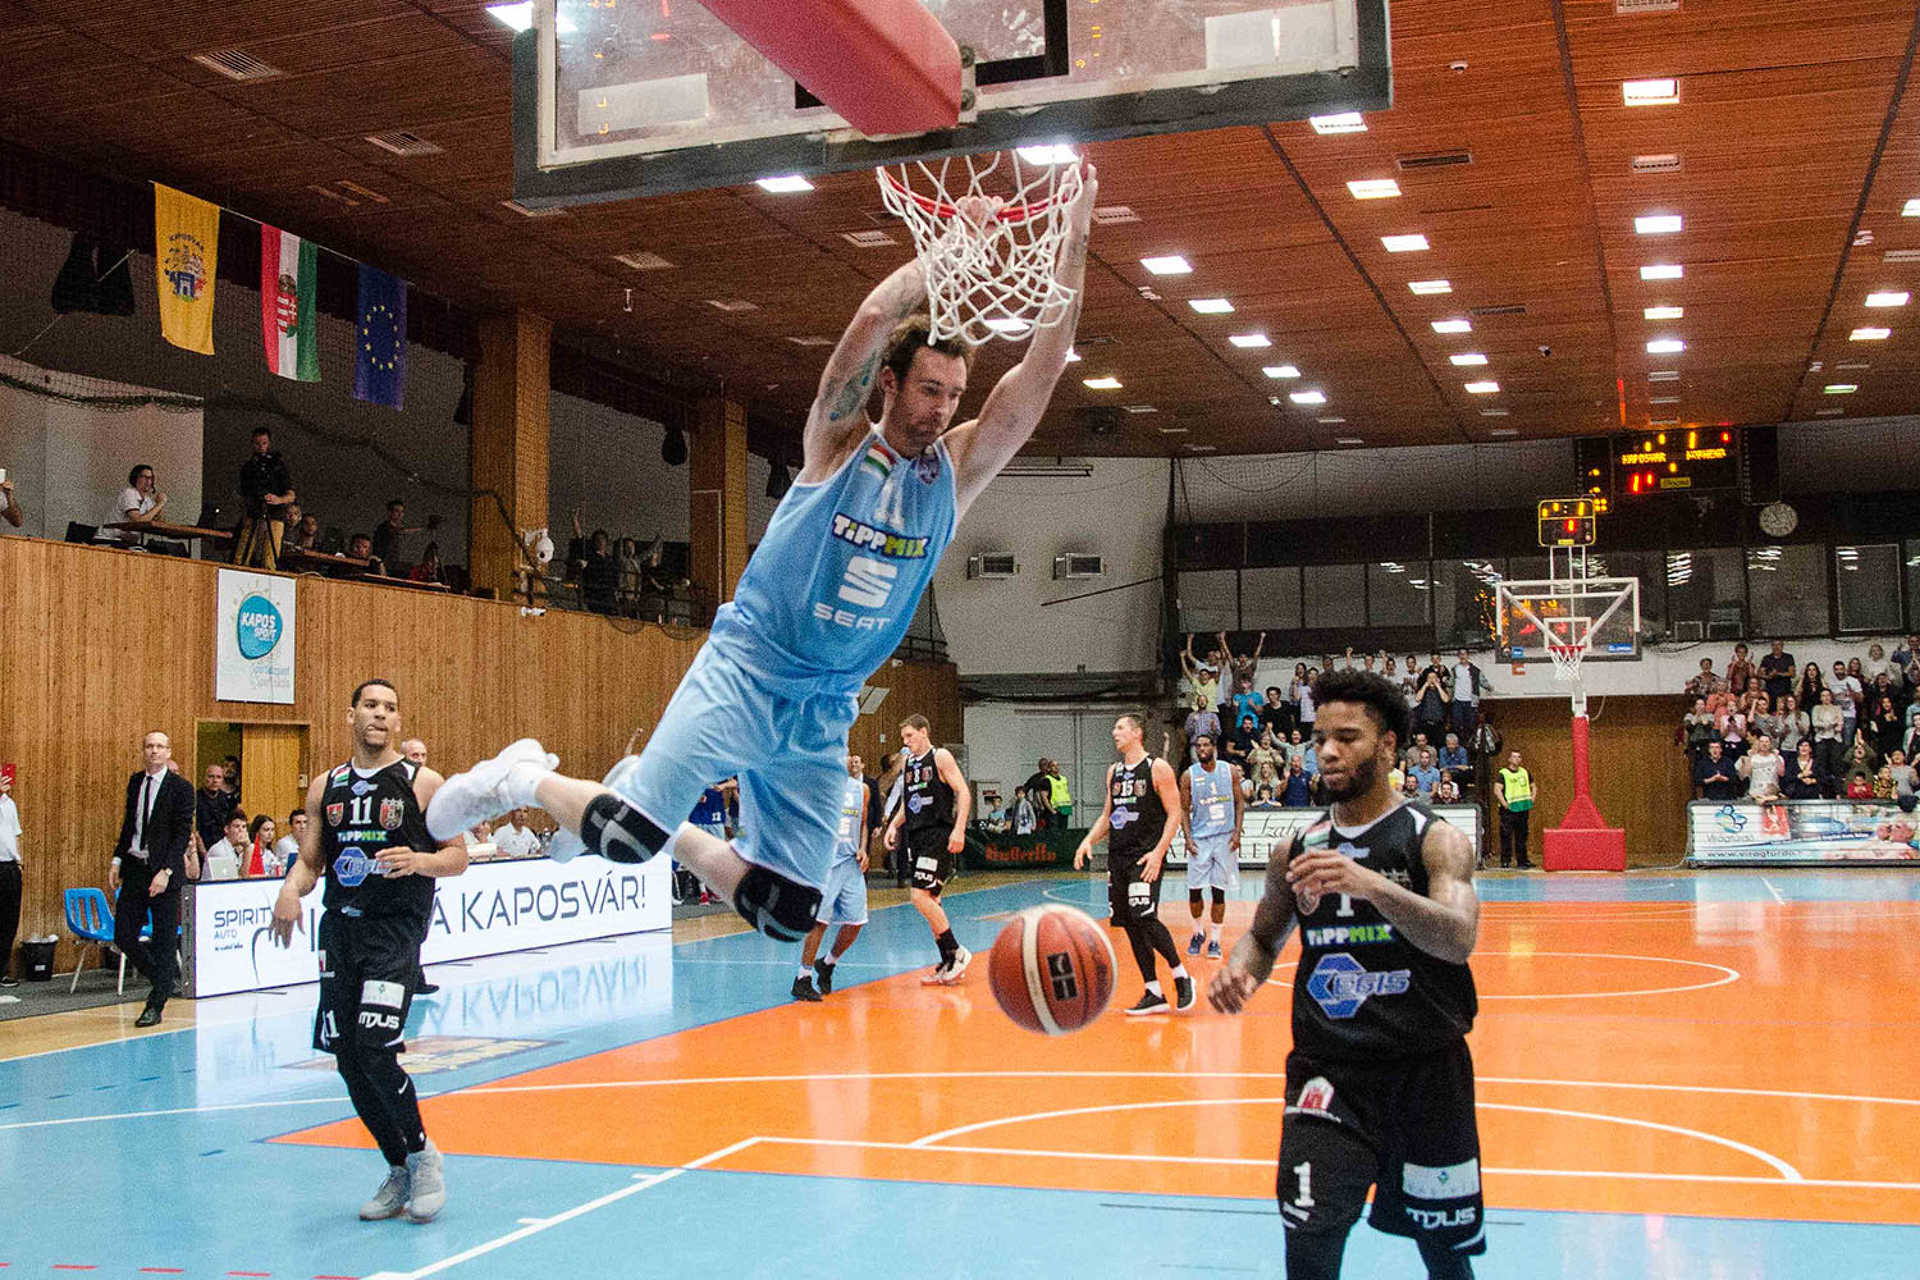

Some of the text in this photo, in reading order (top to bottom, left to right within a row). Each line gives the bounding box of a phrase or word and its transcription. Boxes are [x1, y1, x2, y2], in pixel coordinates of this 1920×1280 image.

[242, 612, 276, 629] KAPOS
[813, 602, 891, 631] SEAT
[1120, 780, 1134, 796] 15
[349, 797, 372, 825] 11
[462, 870, 646, 933] KAPOSVÁR!
[214, 907, 272, 928] SPIRIT
[214, 929, 238, 939] AUTO
[1294, 1160, 1315, 1207] 1
